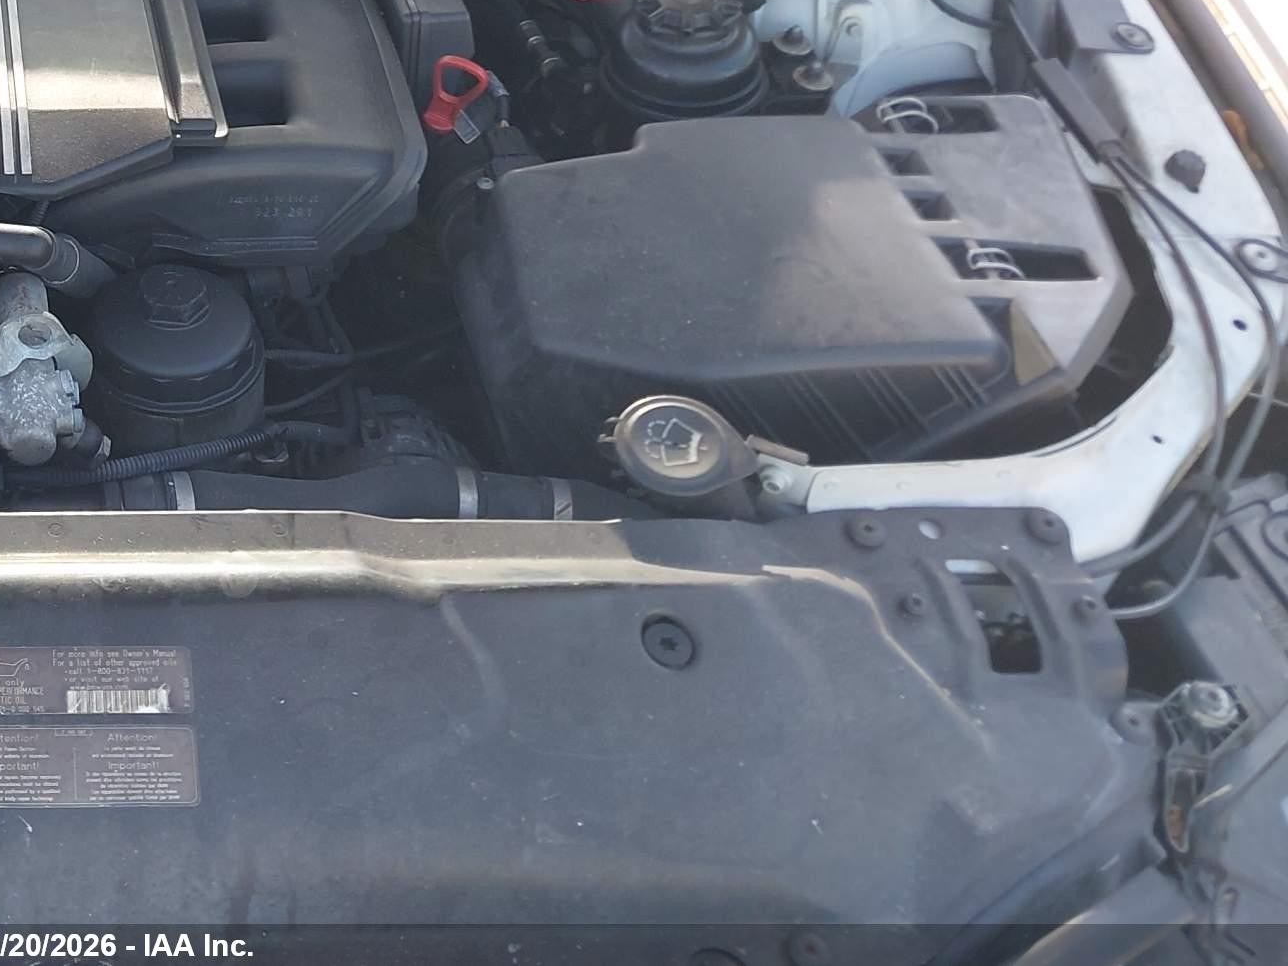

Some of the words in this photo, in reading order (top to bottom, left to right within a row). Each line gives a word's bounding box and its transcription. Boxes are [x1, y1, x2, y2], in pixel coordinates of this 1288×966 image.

[152, 649, 177, 657] Manual
[52, 658, 65, 667] For
[77, 658, 90, 666] list
[4, 678, 25, 688] only
[14, 696, 27, 705] OIL
[106, 733, 158, 742] Attention!
[107, 761, 160, 771] Important!
